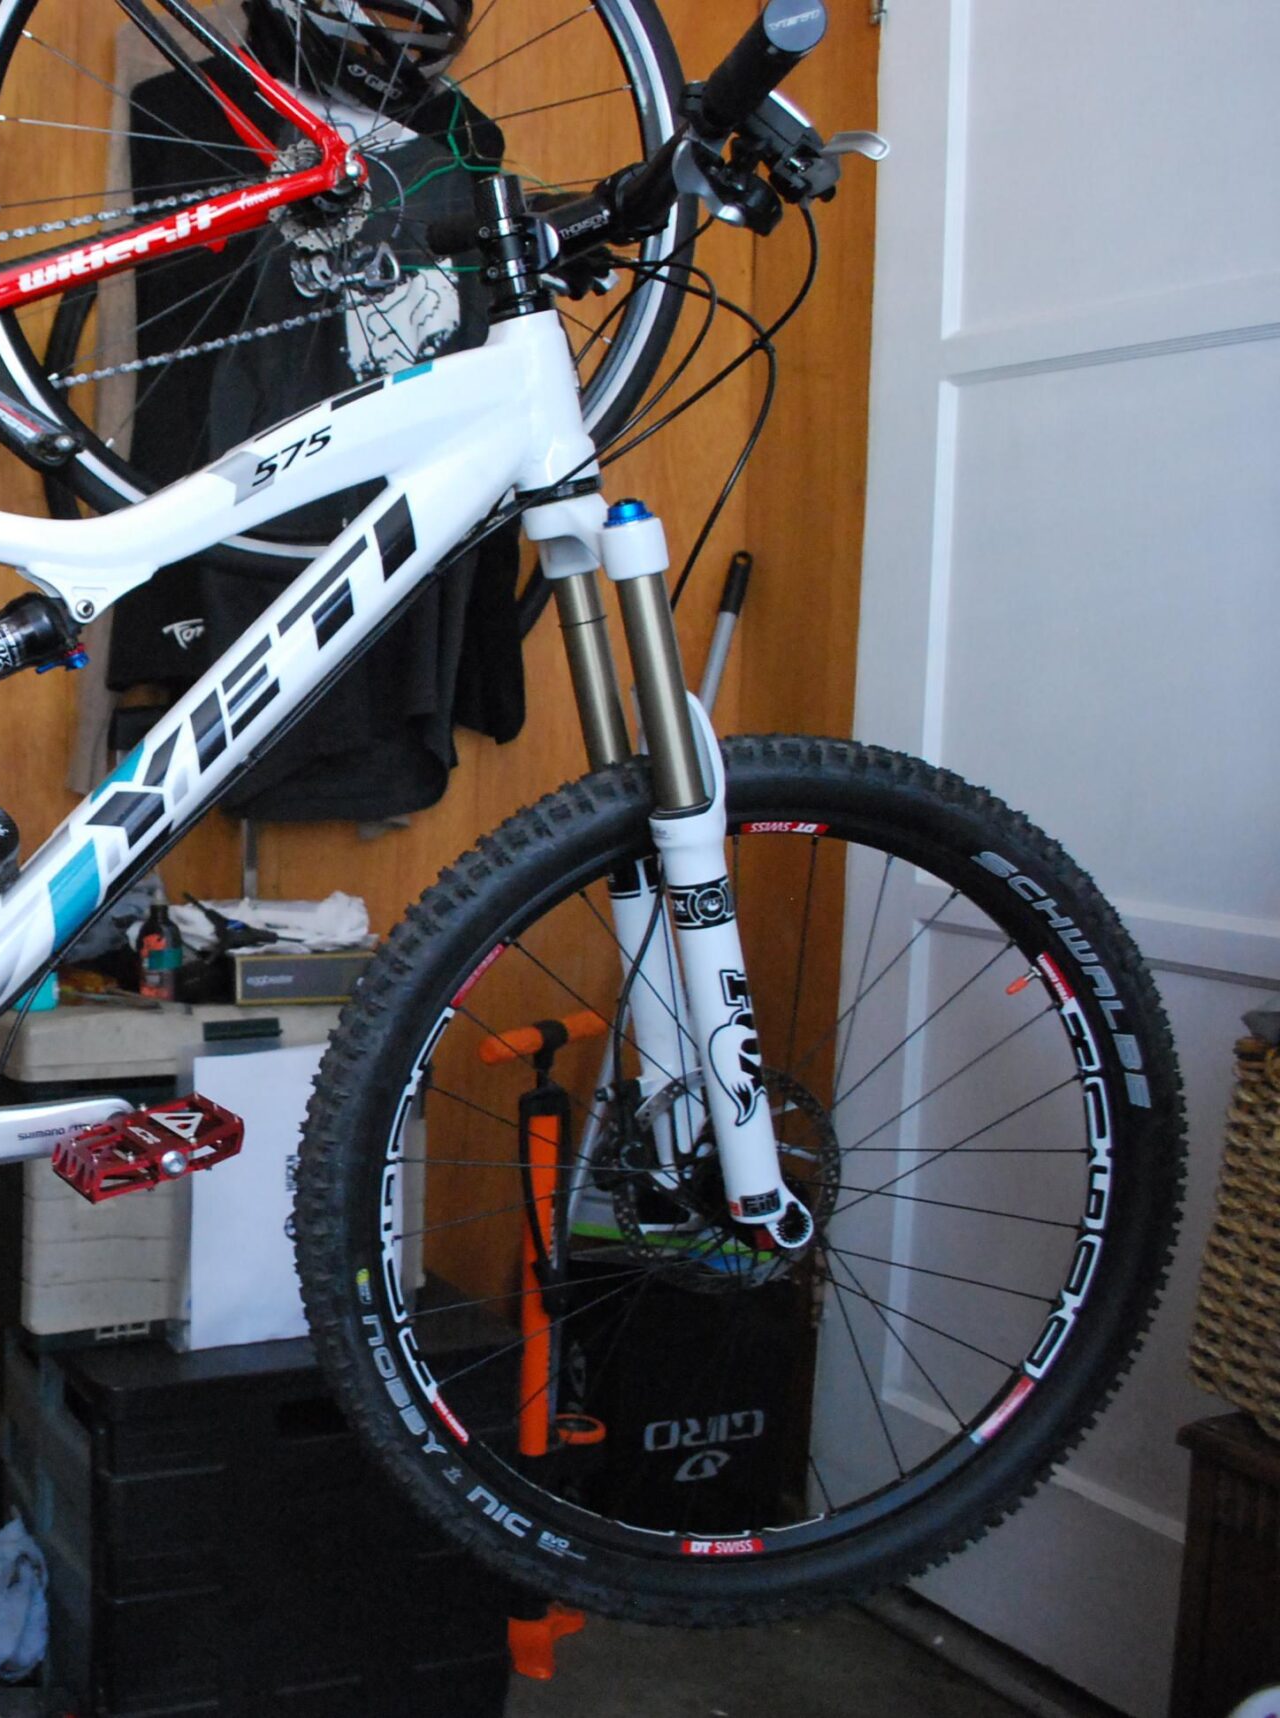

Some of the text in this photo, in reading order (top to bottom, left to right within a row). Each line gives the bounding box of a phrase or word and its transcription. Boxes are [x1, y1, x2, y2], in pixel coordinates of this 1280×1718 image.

[559, 212, 610, 238] THOMSON
[20, 203, 219, 292] wilier.it
[251, 424, 332, 487] 575
[85, 492, 418, 851] YETI
[749, 821, 818, 833] DT SWISS
[970, 851, 1152, 1109] SCHWALBE
[17, 1128, 66, 1141] SHIMANO
[644, 1409, 765, 1451] GIRO
[689, 1539, 755, 1554] DT SWISS
